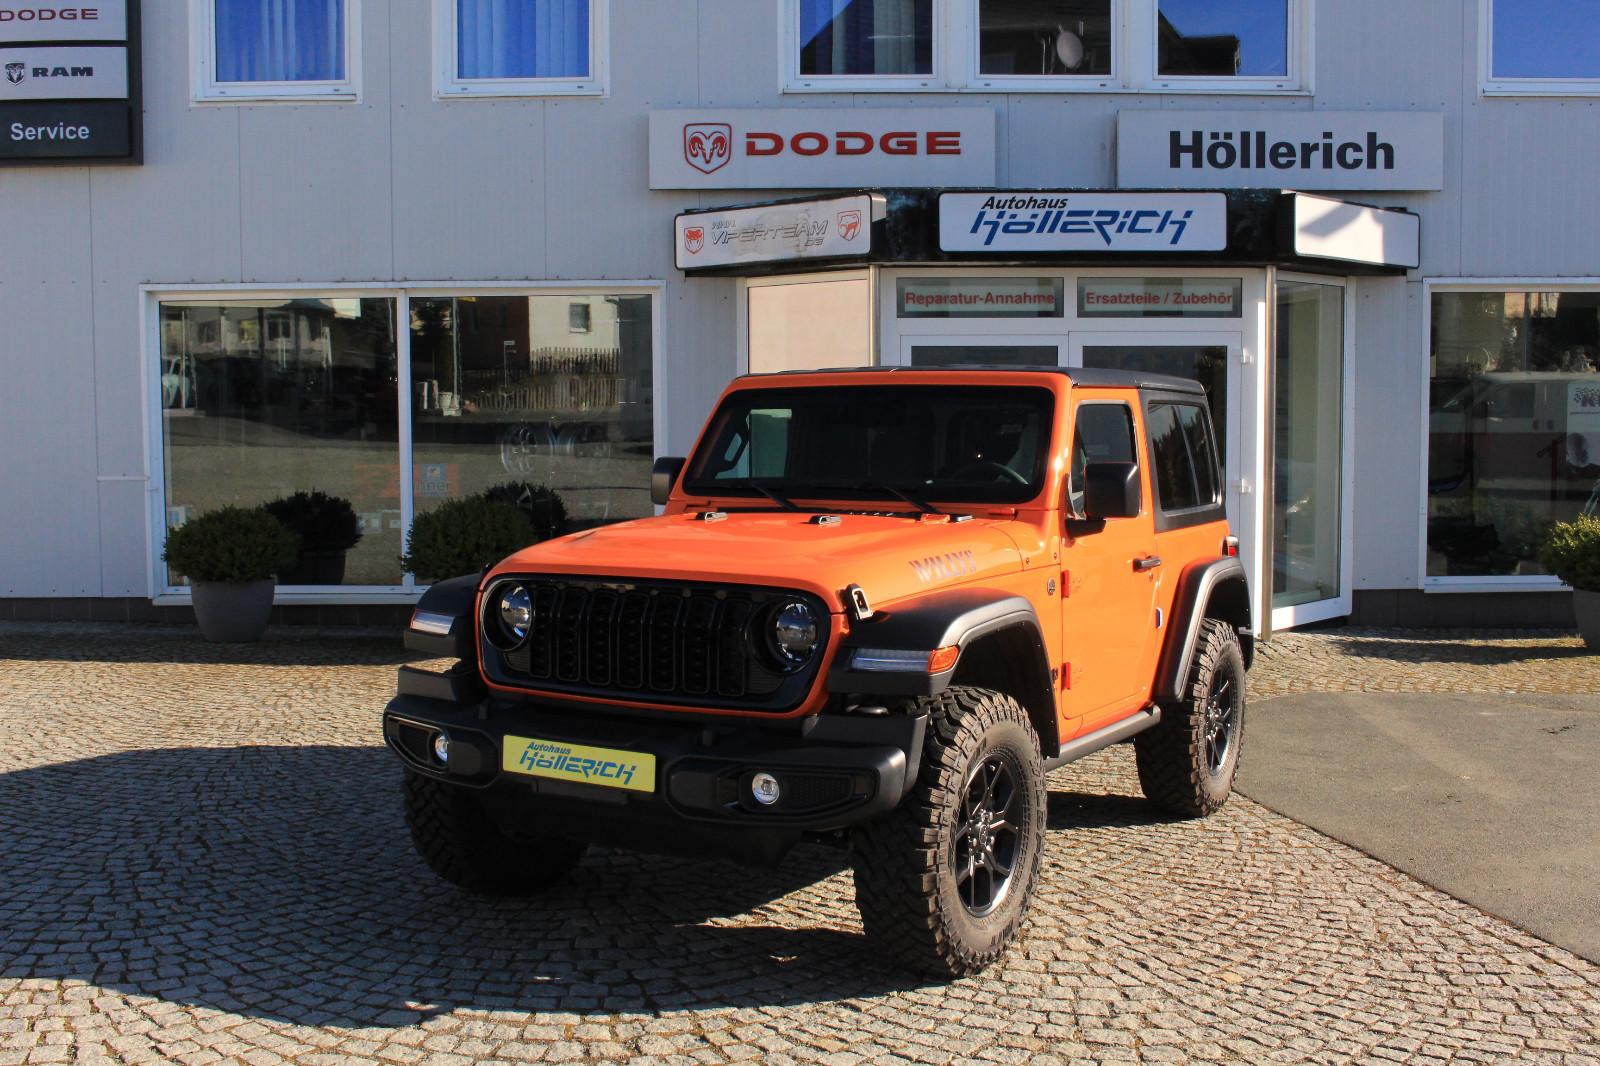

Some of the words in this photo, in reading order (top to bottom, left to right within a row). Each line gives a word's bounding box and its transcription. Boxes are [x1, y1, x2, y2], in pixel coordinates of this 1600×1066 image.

[0, 9, 98, 21] DODGE
[32, 67, 93, 77] RAM
[11, 122, 89, 140] Service
[746, 131, 961, 156] DODGE
[1169, 130, 1395, 170] Höllerich
[980, 195, 1069, 210] Autohaus
[904, 291, 1055, 306] Reparatur-Annahme
[1085, 292, 1161, 305] Ersatzteile
[1172, 291, 1233, 305] Zubehör
[527, 741, 572, 755] Autohaus
